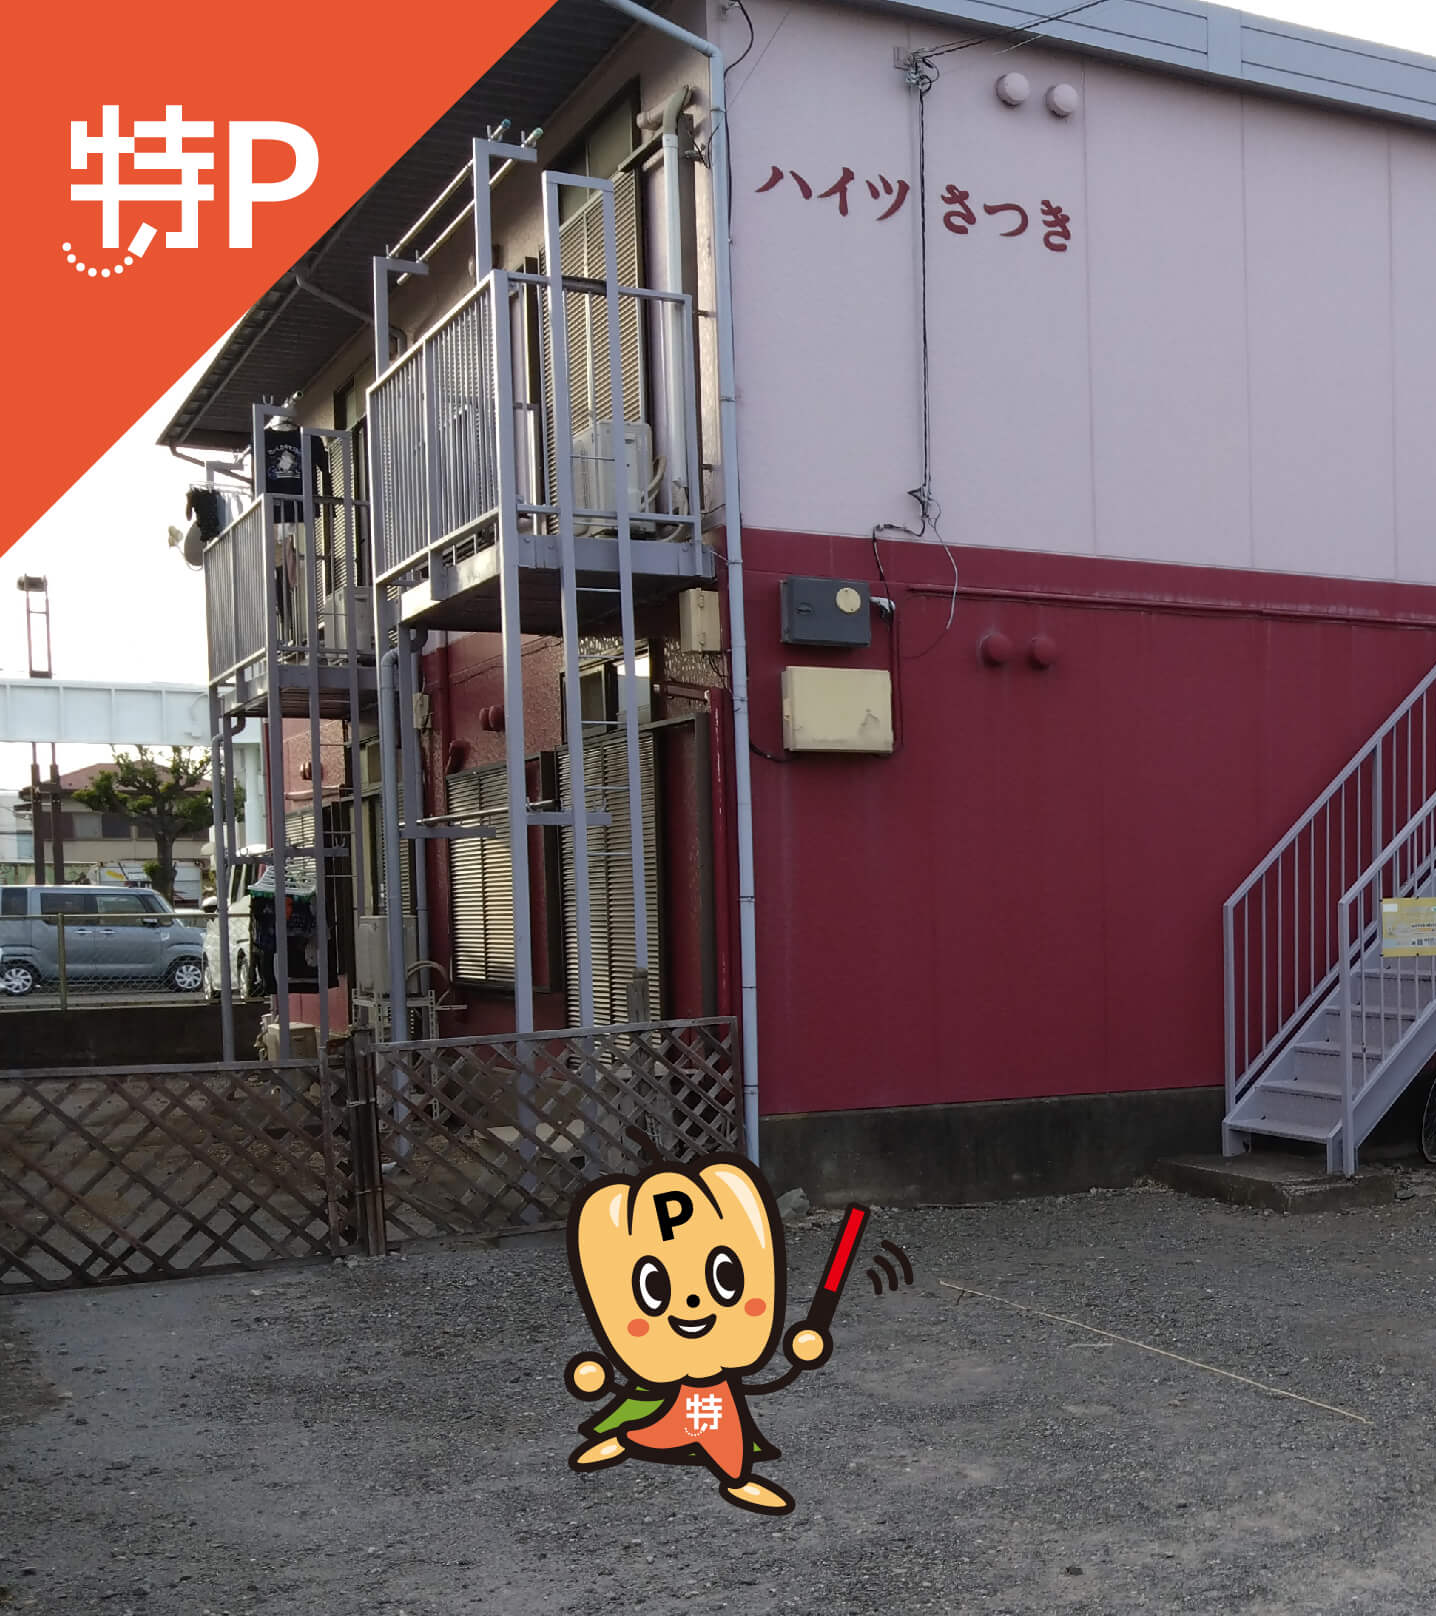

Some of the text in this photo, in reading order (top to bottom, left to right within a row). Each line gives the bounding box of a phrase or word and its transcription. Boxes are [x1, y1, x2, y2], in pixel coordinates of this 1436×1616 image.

[758, 166, 1071, 253] ハイツ さつき
